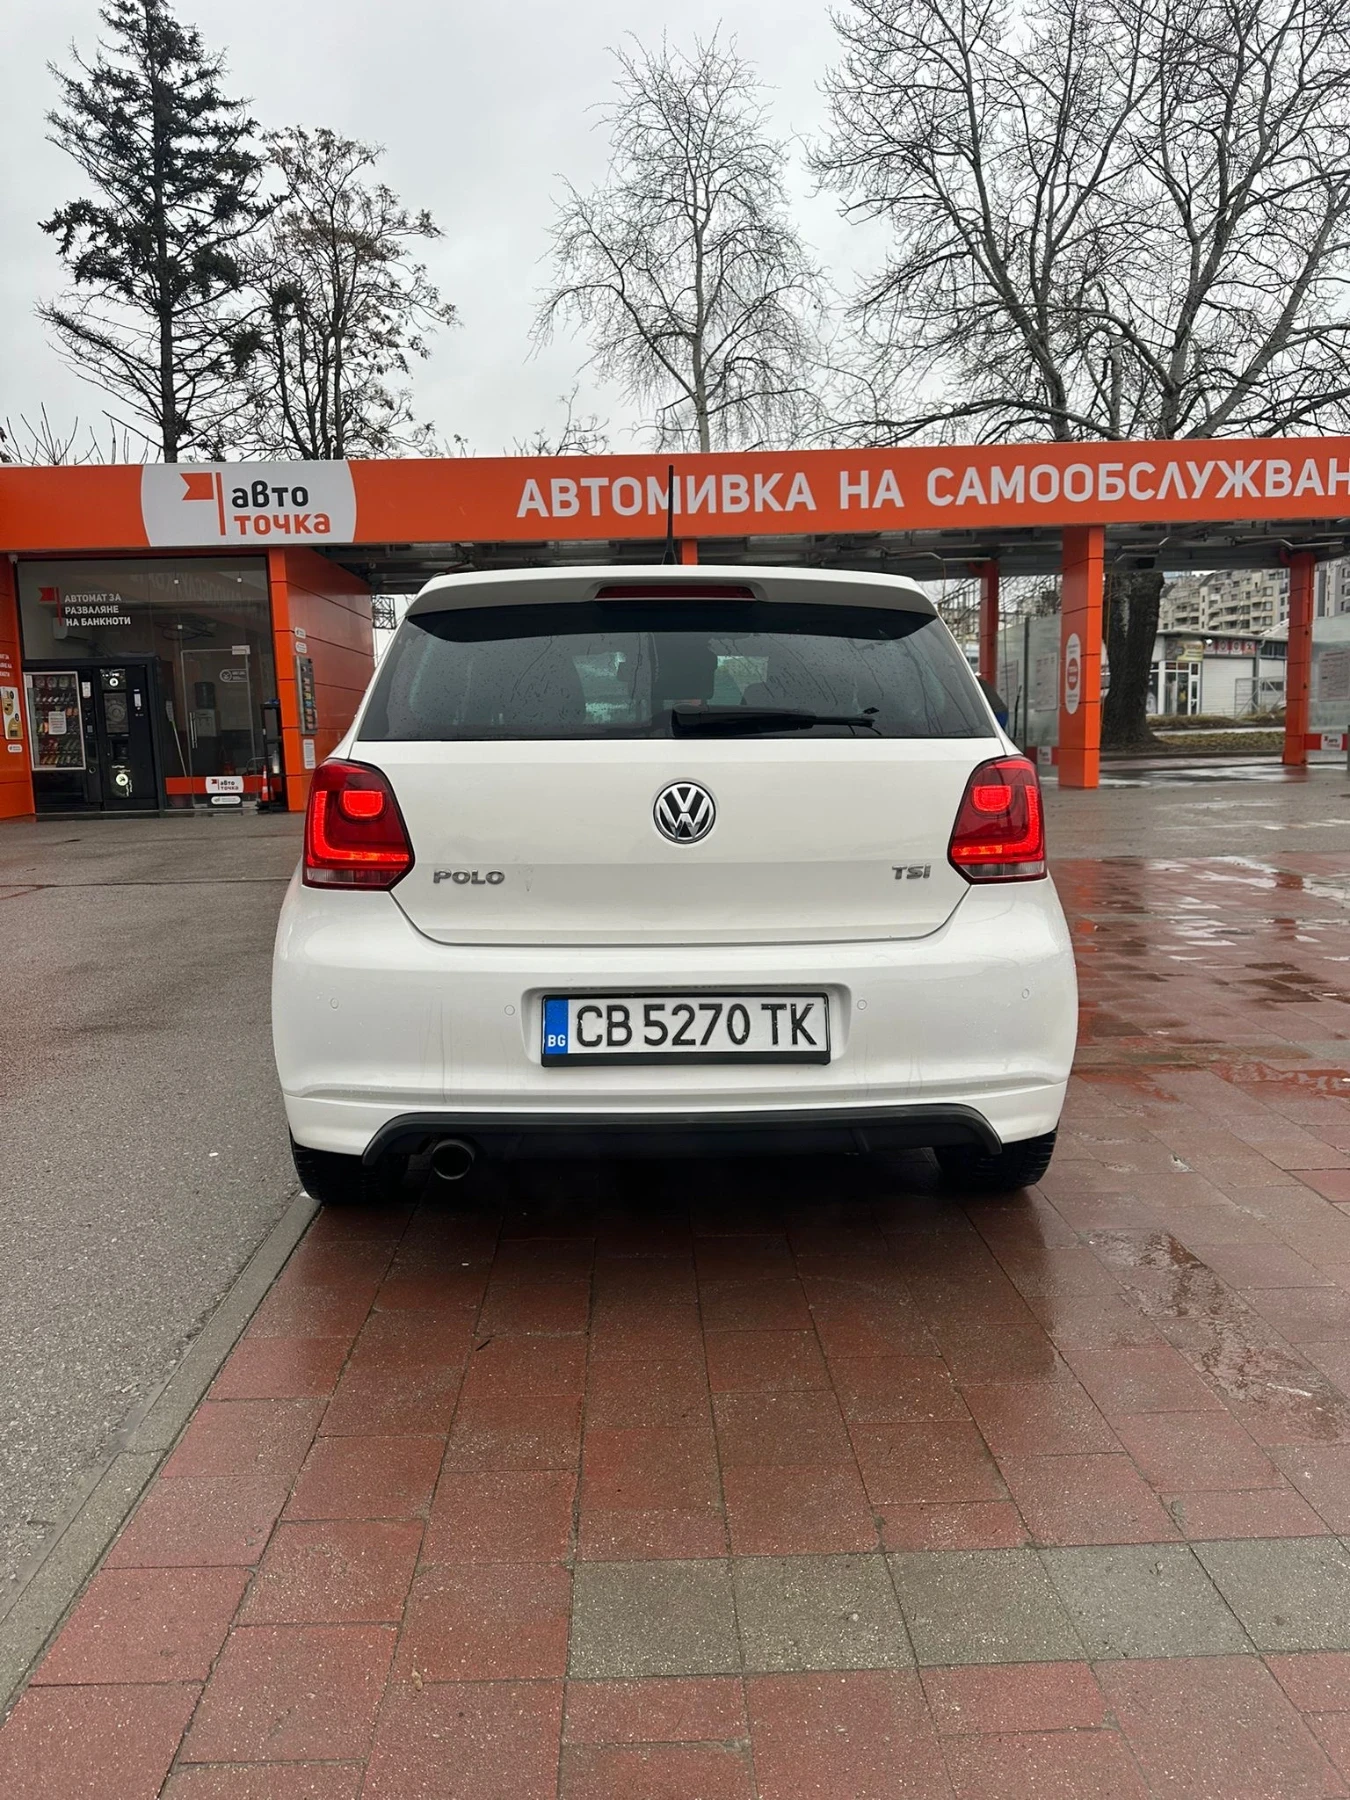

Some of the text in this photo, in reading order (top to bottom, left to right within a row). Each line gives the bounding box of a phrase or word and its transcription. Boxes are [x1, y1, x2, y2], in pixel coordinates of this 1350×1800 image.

[232, 480, 309, 508] авто
[516, 472, 817, 517] АВТОМИВКА
[839, 469, 905, 510] НА
[234, 512, 331, 536] точка
[64, 593, 121, 602] АВТОМАТ ЗА
[65, 605, 119, 614] РАЗВАЛЯНЕ
[66, 616, 131, 626] НА БАНКНОТИ
[433, 869, 505, 885] POLO
[891, 864, 931, 880] TSI
[576, 1003, 818, 1048] CB 5270 TK
[547, 1034, 567, 1047] BG
